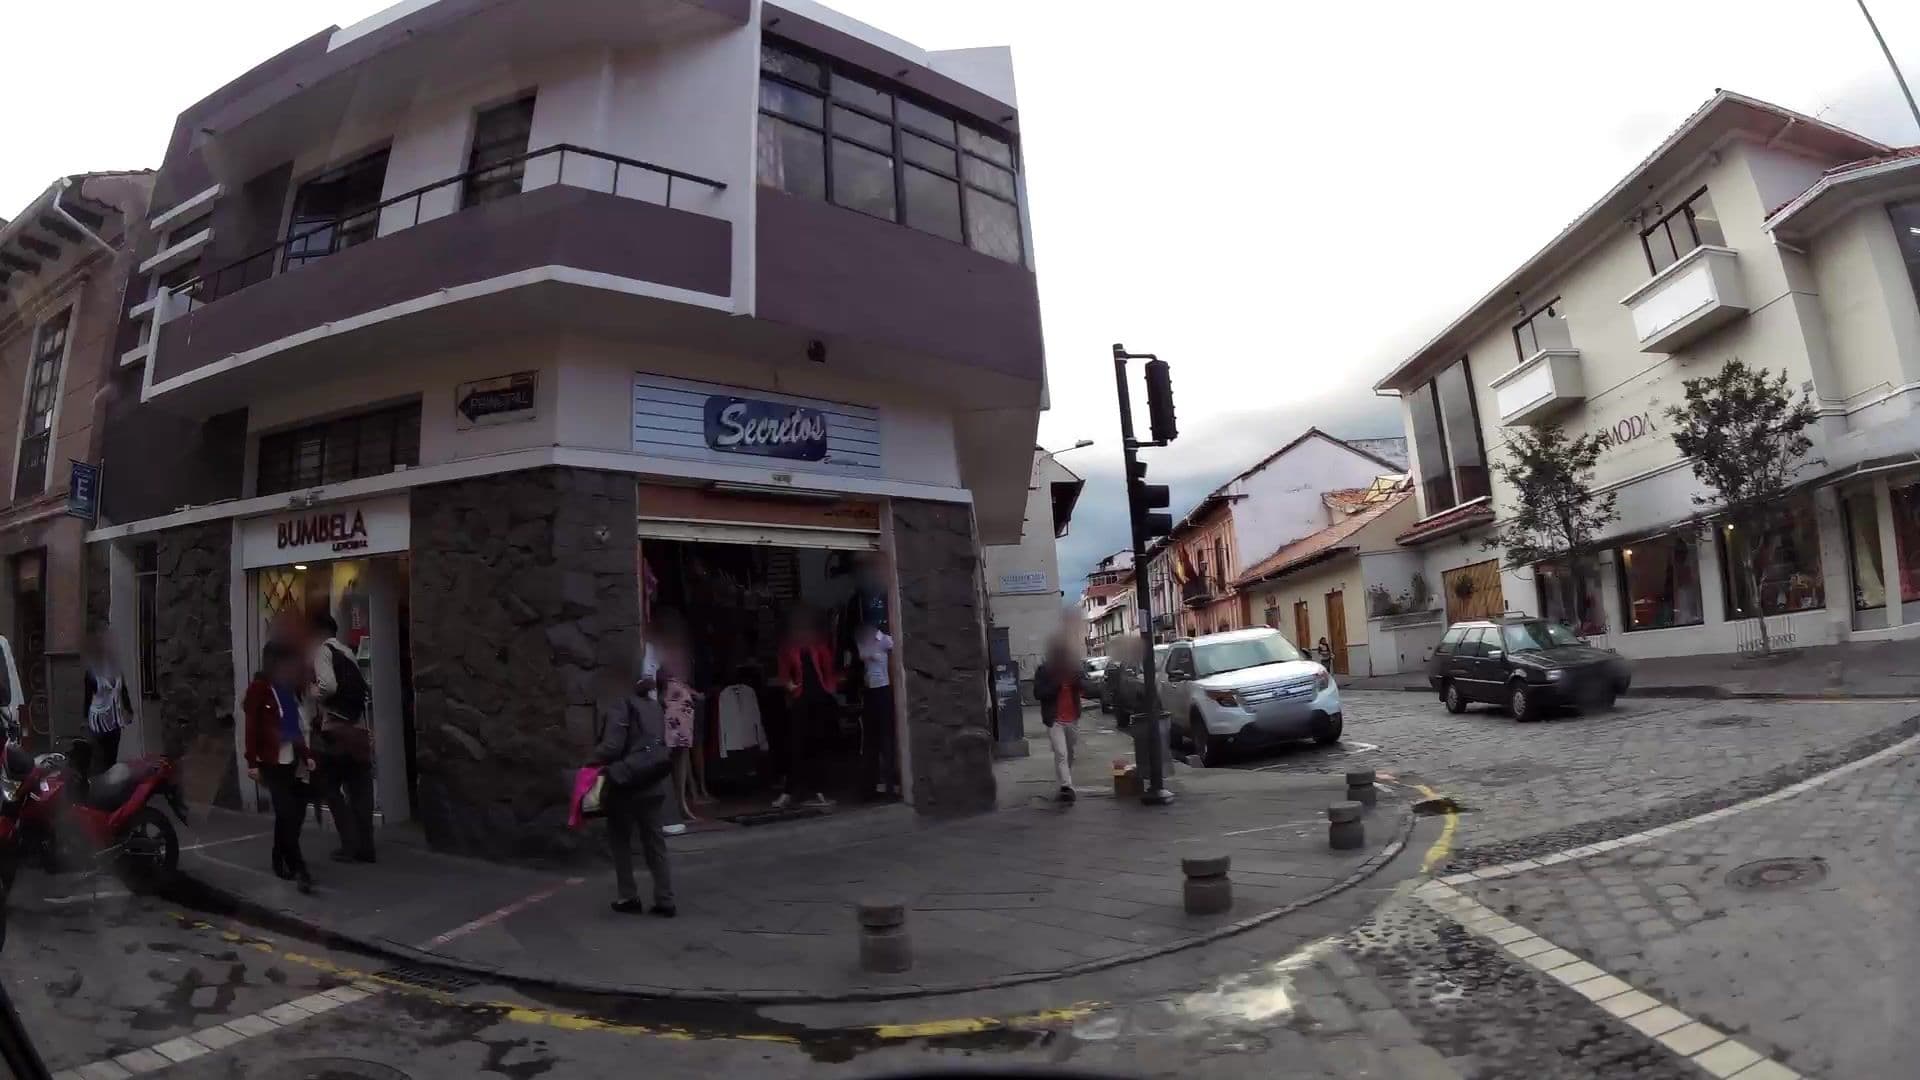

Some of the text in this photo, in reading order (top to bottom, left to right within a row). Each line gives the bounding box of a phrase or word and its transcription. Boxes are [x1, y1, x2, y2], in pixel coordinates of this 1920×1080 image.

[717, 402, 825, 446] Secretos
[1602, 411, 1657, 447] MODA
[277, 508, 367, 550] BUMBELA
